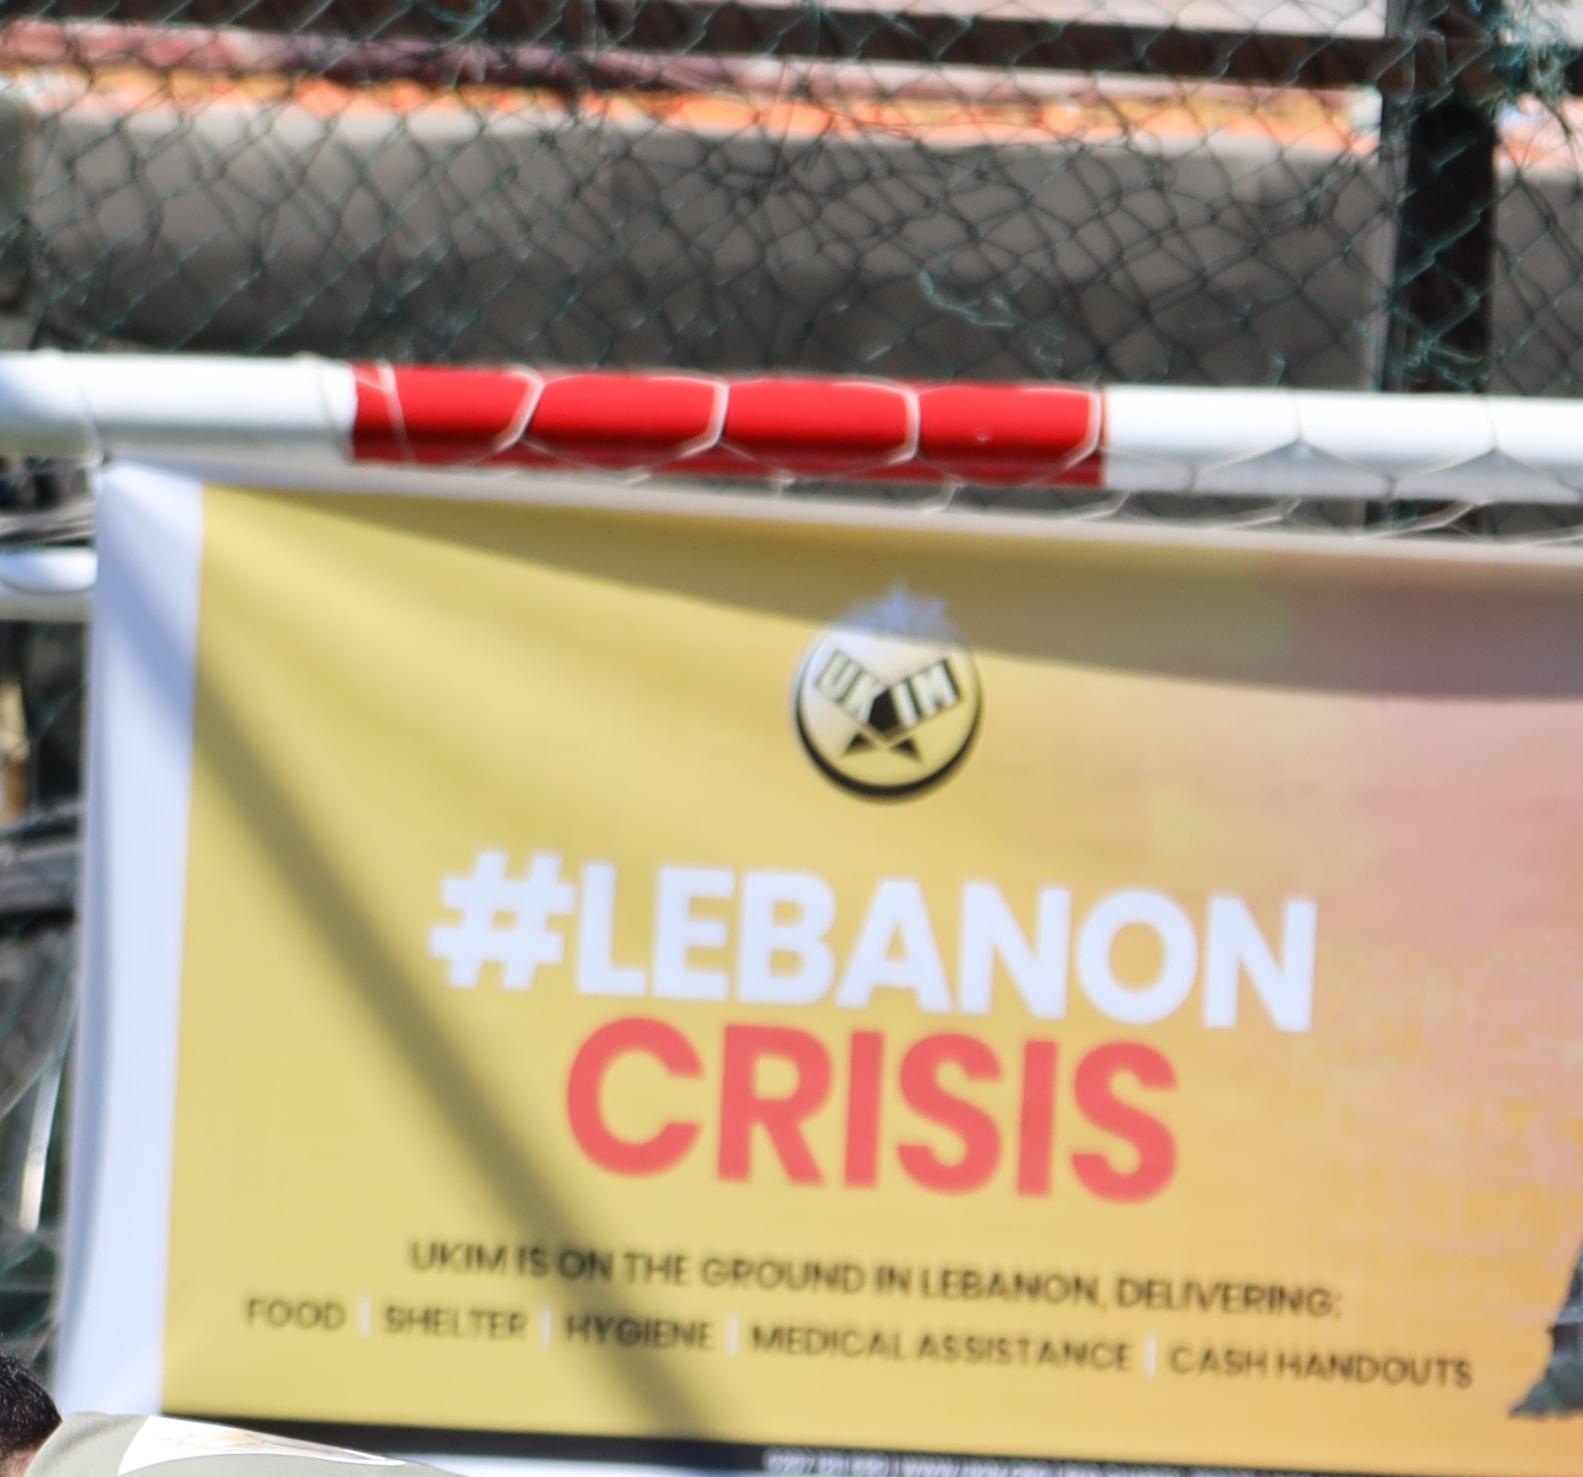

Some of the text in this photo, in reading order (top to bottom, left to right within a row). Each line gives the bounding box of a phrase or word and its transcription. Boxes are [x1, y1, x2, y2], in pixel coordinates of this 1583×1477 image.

[817, 652, 957, 728] UKIM
[430, 848, 1318, 1034] #LEBANON
[566, 1014, 1178, 1204] CRISIS
[411, 1239, 506, 1275] UKIM
[518, 1247, 548, 1277] IS
[558, 1247, 614, 1282] ON
[623, 1251, 688, 1285] THE
[701, 1256, 865, 1294] GROUND
[876, 1264, 911, 1297] IN
[920, 1266, 1107, 1312] LEBANON,
[247, 1297, 1473, 1389] FOOD SHELTER HYGIENE MEDICAL ASSISTANCE CASH HANDOUTS
